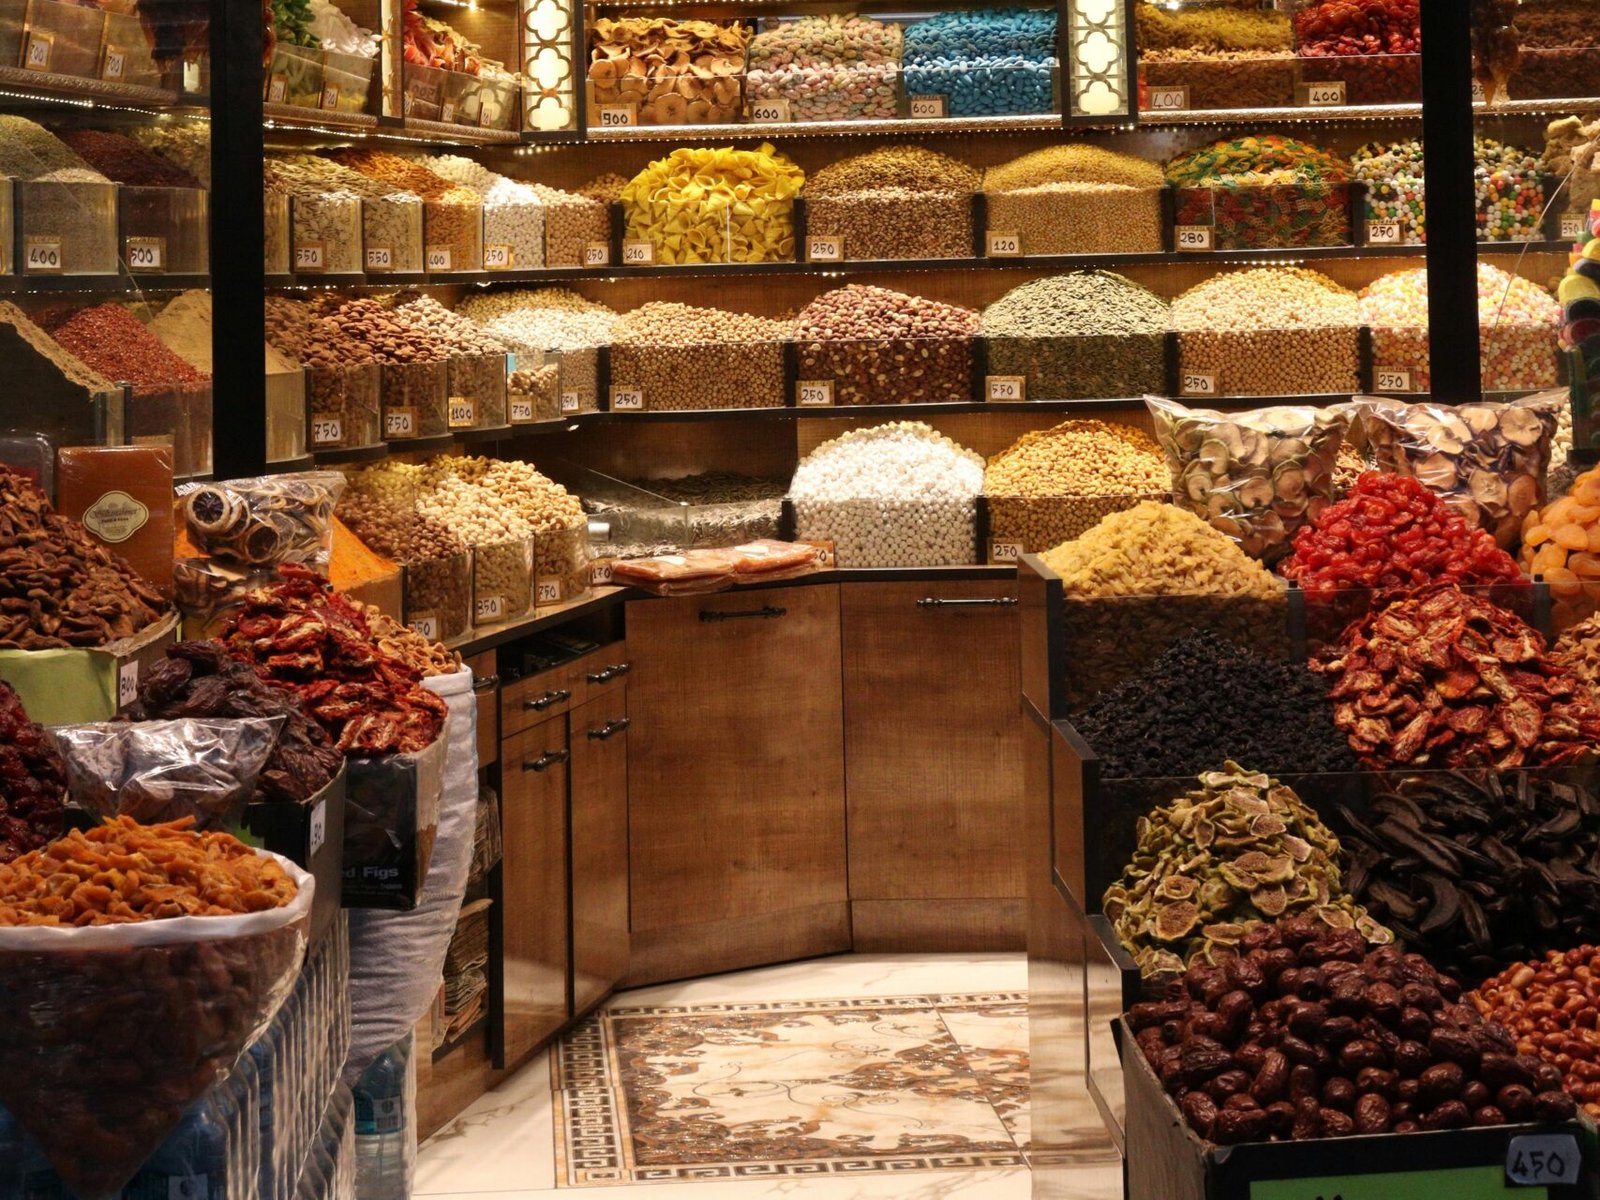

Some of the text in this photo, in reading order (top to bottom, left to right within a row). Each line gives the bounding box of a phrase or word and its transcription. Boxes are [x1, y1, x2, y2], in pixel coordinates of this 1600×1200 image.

[1153, 93, 1183, 108] 400
[1312, 92, 1338, 102] 400
[755, 109, 778, 119] 600
[913, 103, 935, 114] 600
[603, 113, 628, 125] 900
[1181, 232, 1203, 243] 280
[1372, 226, 1393, 238] 250
[813, 243, 834, 254] 250
[994, 240, 1015, 251] 120
[31, 248, 57, 265] 400
[130, 248, 153, 263] 500
[297, 249, 317, 262] 550
[369, 252, 388, 263] 550
[486, 250, 503, 261] 250
[587, 249, 603, 260] 250
[627, 248, 643, 259] 210
[429, 255, 444, 265] 400
[1185, 376, 1208, 390] 250
[1379, 374, 1402, 387] 250
[802, 389, 823, 401] 250
[992, 385, 1013, 396] 550
[616, 393, 637, 405] 250
[513, 405, 530, 416] 750
[388, 417, 408, 430] 750
[315, 423, 338, 439] 750
[995, 545, 1016, 557] 250
[539, 585, 556, 598] 750
[363, 866, 399, 880] Figs
[1512, 1151, 1565, 1178] 450
